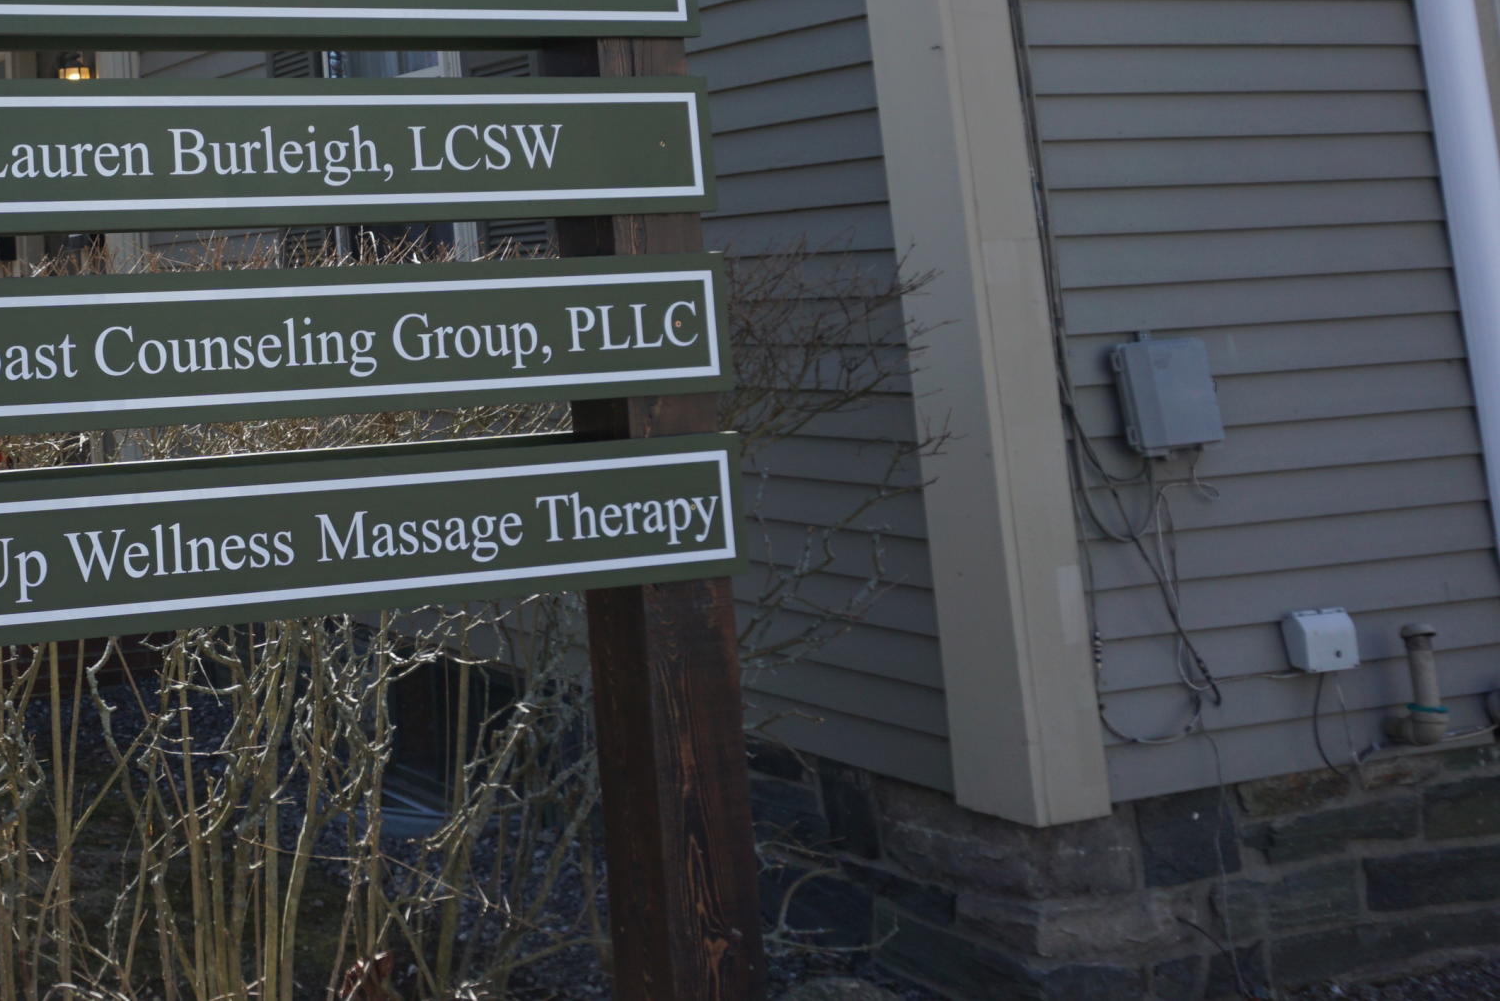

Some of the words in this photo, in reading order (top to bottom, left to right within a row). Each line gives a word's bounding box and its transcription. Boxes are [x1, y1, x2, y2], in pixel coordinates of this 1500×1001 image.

[166, 124, 394, 187] Burleigh,
[406, 123, 564, 172] LCSW
[94, 316, 378, 378] Counseling
[392, 312, 553, 370] Group,
[564, 300, 699, 353] PLLC
[63, 522, 295, 583] Wellness
[314, 510, 524, 563] Massage
[535, 491, 719, 546] Therapy
